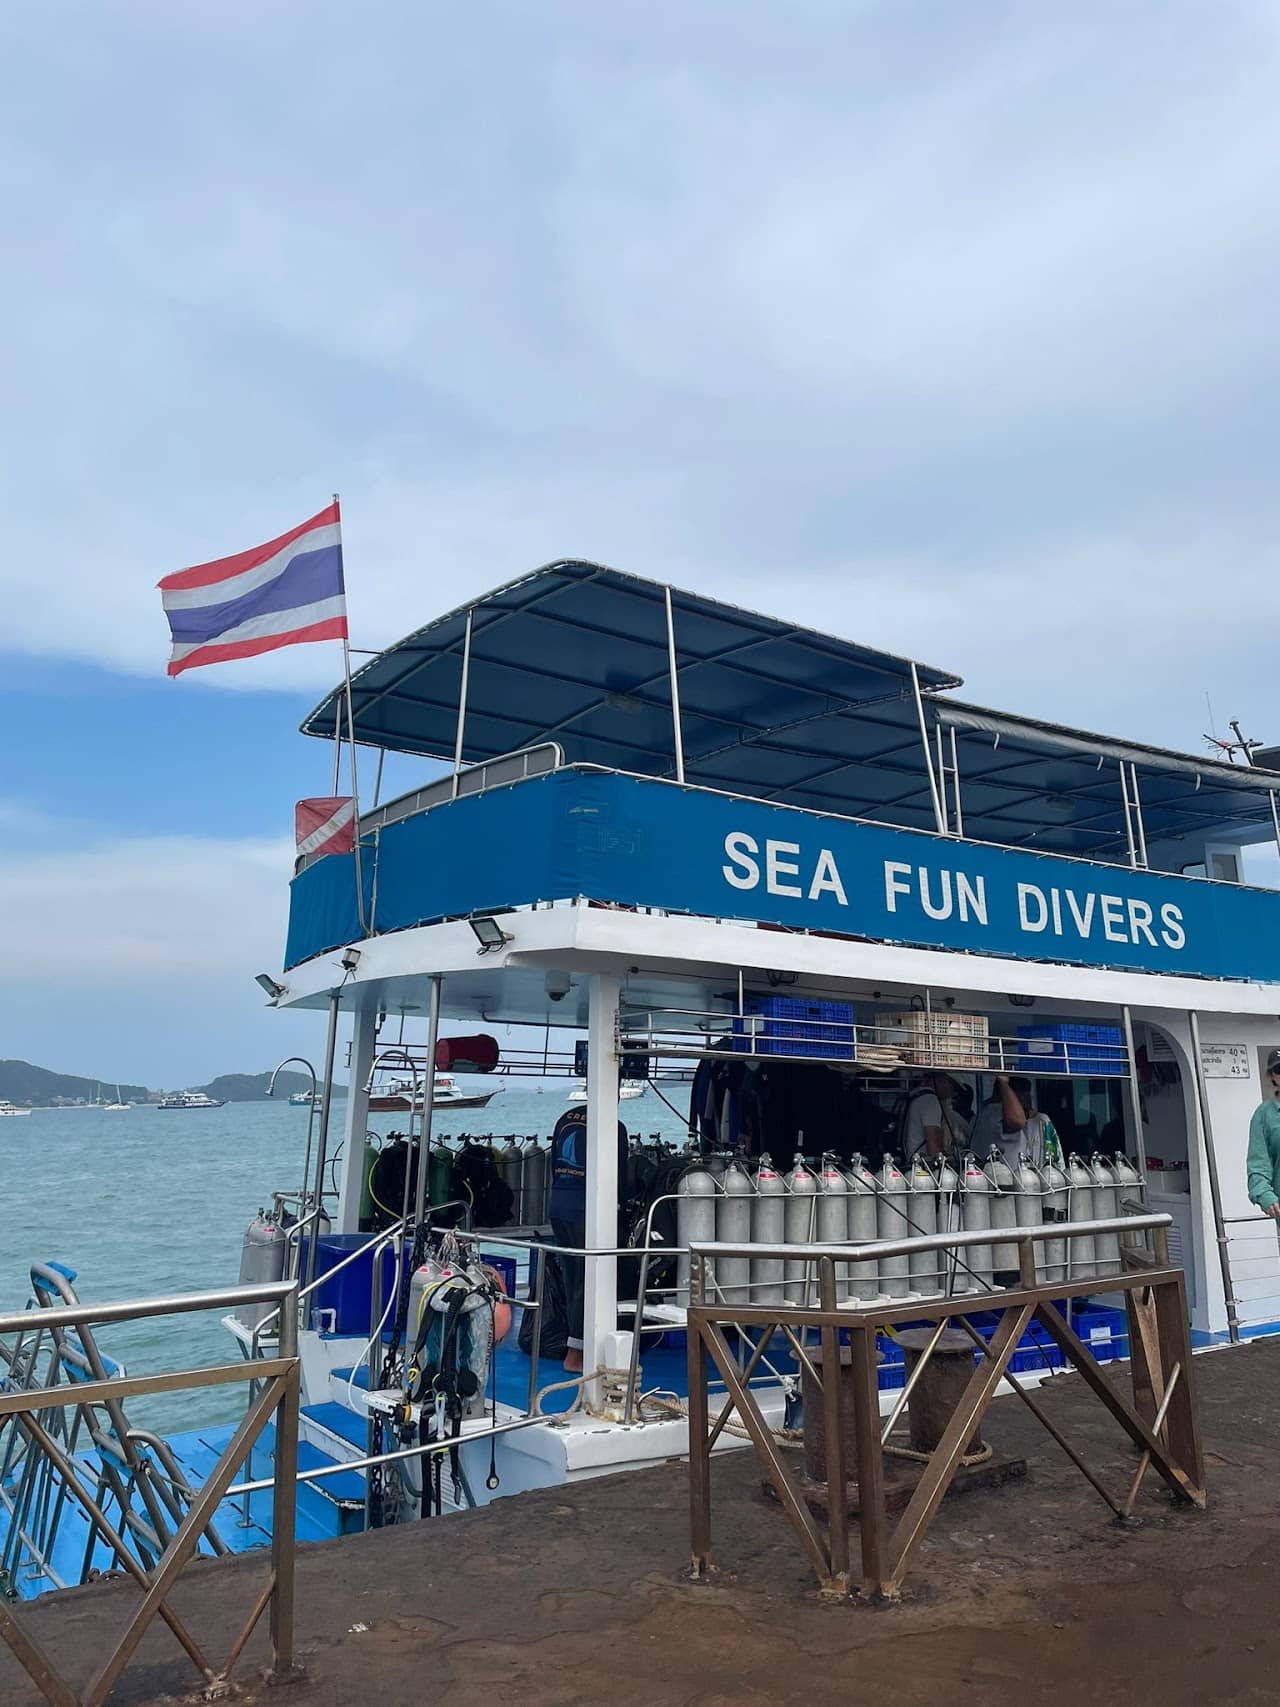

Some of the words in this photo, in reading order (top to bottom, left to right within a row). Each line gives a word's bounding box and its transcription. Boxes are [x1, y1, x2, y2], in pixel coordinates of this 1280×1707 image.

[722, 831, 848, 906] SEA
[884, 860, 988, 925] FUN
[1016, 882, 1186, 950] DIVERS
[1229, 1048, 1238, 1057] 40
[1231, 1066, 1241, 1074] 43
